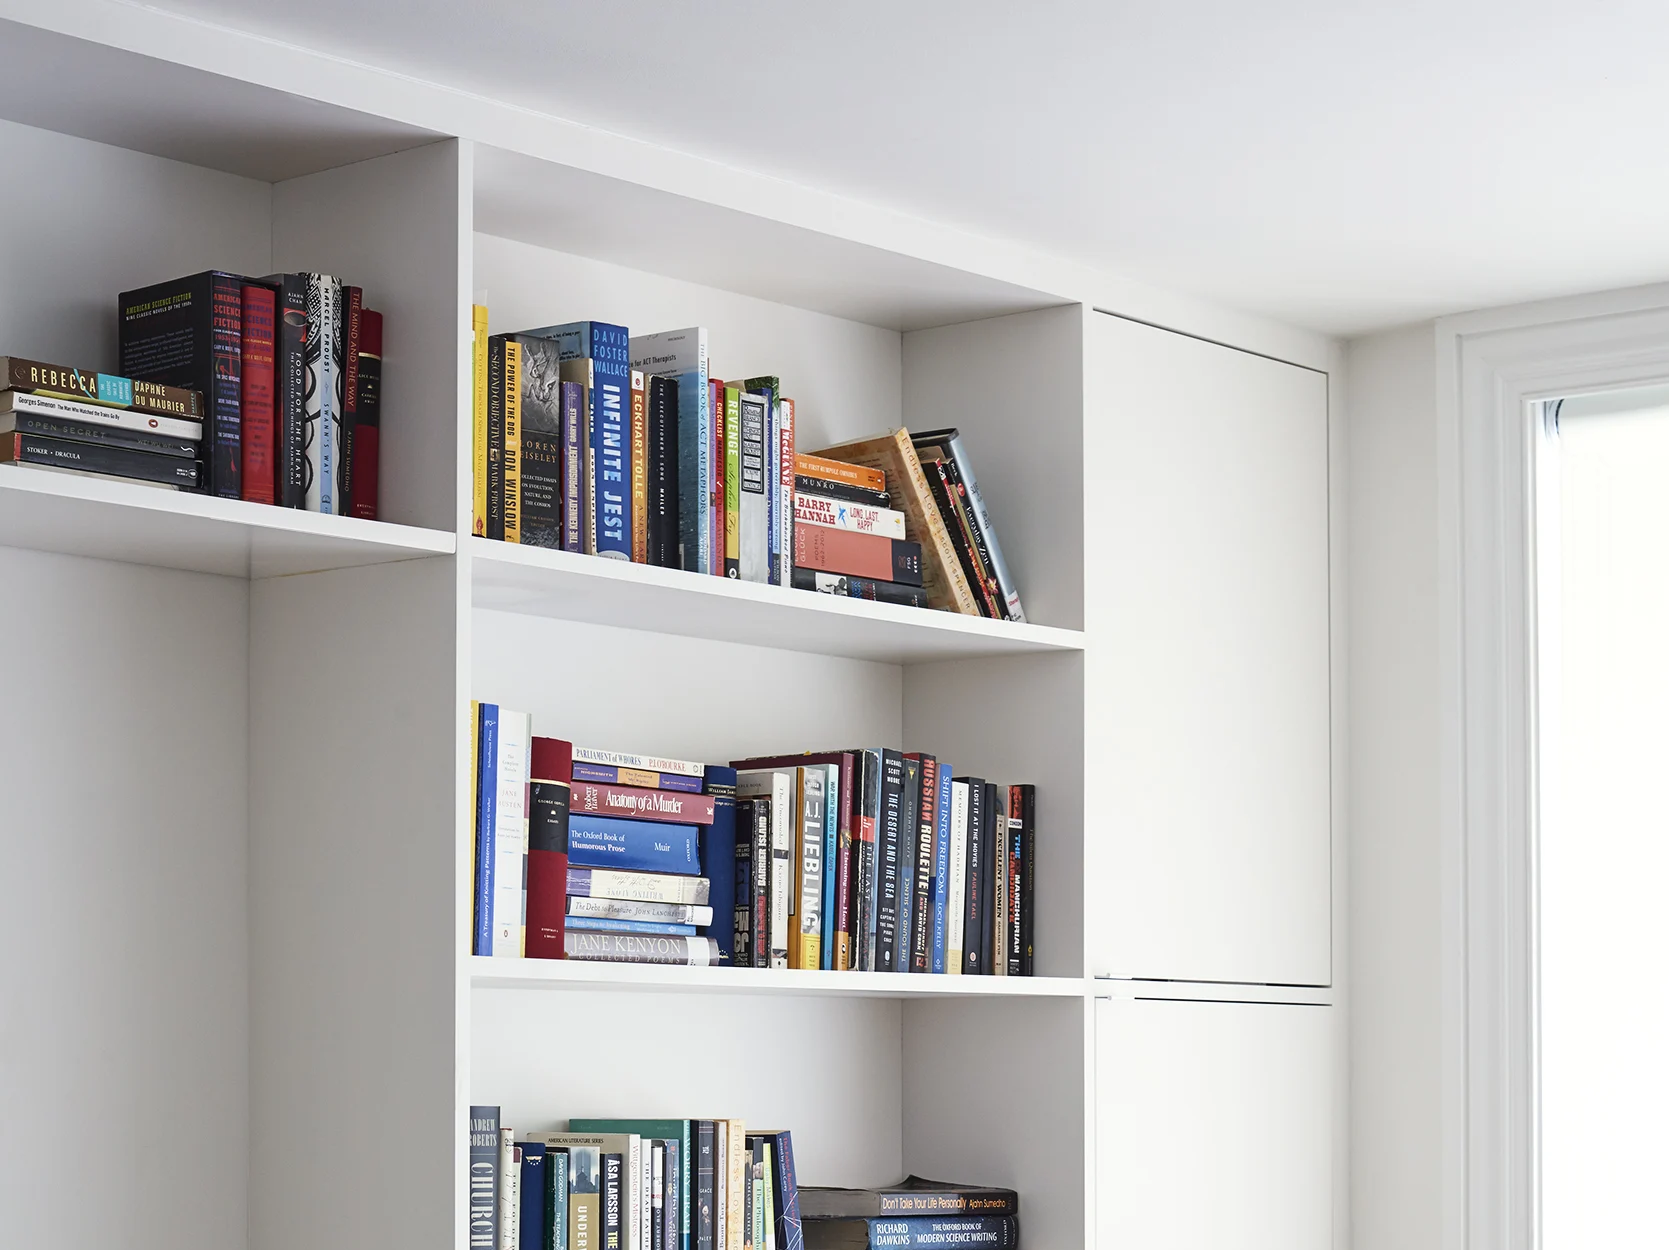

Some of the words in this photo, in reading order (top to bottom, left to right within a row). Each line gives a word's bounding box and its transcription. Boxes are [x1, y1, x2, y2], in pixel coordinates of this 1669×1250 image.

[126, 302, 150, 315] AMERICAN
[152, 297, 171, 310] SCIENCE
[172, 292, 192, 303] FICTION
[352, 293, 360, 309] THE
[350, 313, 359, 339] MIND
[594, 329, 628, 346] DAVID
[349, 340, 358, 362] AND
[507, 348, 515, 361] THE
[594, 345, 628, 362] FOSTER
[642, 357, 651, 365] ACT
[652, 354, 677, 364] Therapists
[348, 366, 357, 388] THE
[507, 364, 515, 392] POWER
[594, 361, 628, 377] WALLACE
[31, 367, 96, 393] REBECCA
[135, 381, 165, 396] DAPHNE
[135, 395, 146, 406] DU
[149, 397, 185, 413] MAURIER
[347, 389, 356, 406] WAY
[507, 394, 515, 404] OF
[507, 406, 515, 420] THE
[27, 420, 57, 431] OPEN
[63, 425, 105, 439] SECRET
[507, 421, 515, 436] DOG
[602, 384, 623, 482] INFINITE
[634, 394, 643, 456] ECKHART
[728, 400, 738, 457] REVENGE
[27, 446, 48, 455] STOKER
[55, 450, 80, 460] DRACULA
[505, 450, 516, 471] DON
[491, 462, 499, 488] MARK
[569, 444, 578, 497] IMPRISONMENT
[635, 458, 643, 499] TOLLE
[808, 463, 820, 471] FIRST
[820, 465, 839, 475] RUMPOLE
[839, 469, 858, 479] OMNIBUS
[901, 437, 923, 489] Endless
[923, 494, 939, 523] Love
[802, 478, 835, 490] MUNRO
[491, 490, 499, 520] FROST
[505, 478, 517, 530] WINSLOW
[798, 497, 832, 513] BARRY
[569, 498, 578, 530] KENNEDY
[603, 491, 623, 541] JEST
[795, 508, 836, 525] HANNAH
[857, 519, 873, 532] HAPPY
[569, 530, 578, 544] THE
[966, 506, 981, 544] Everyday
[979, 547, 989, 565] Zen
[940, 536, 954, 566] SCOTT
[953, 565, 971, 610] SPENCER
[576, 748, 612, 762] PARLIAMENT
[612, 753, 617, 762] of
[618, 754, 642, 766] WHORES
[501, 789, 517, 798] JANE
[584, 786, 592, 810] Robert
[922, 759, 935, 822] RUSSIAN
[941, 776, 950, 807] SHIFT
[498, 800, 522, 809] AUSTEN
[888, 793, 899, 808] THE
[758, 816, 767, 847] ISLAND
[887, 810, 897, 842] DESERT
[940, 809, 949, 838] INTO
[571, 830, 582, 839] The
[582, 831, 603, 841] Oxford
[603, 833, 618, 842] Book
[618, 834, 625, 843] of
[572, 841, 606, 852] Humorous
[607, 843, 626, 853] Prose
[654, 841, 671, 852] Muir
[886, 844, 896, 862] AND
[918, 824, 932, 890] ROULETTE
[758, 848, 767, 886] BARRIER
[802, 820, 821, 927] LIEBLING
[886, 865, 896, 880] THE
[937, 841, 947, 894] FREEDOM
[885, 882, 895, 899] SEA
[903, 907, 908, 918] OF
[1013, 874, 1021, 954] MANCHURIAN
[570, 933, 612, 954] JANE
[613, 935, 681, 955] KENYON
[732, 1124, 742, 1183] Endless
[607, 1159, 621, 1180] ÅSA
[629, 1145, 639, 1203] Wittgenstein's
[607, 1181, 619, 1226] LARSSON
[755, 1186, 763, 1204] The
[882, 1198, 900, 1210] Don't
[899, 1198, 913, 1209] Take
[913, 1198, 928, 1209] Your
[927, 1198, 938, 1209] Life
[938, 1197, 967, 1211] Personally
[969, 1200, 984, 1209] Ajahn
[983, 1199, 1006, 1208] Sumedho
[732, 1190, 742, 1226] Love
[631, 1203, 639, 1238] Mistress
[876, 1223, 909, 1234] RICHARD
[932, 1223, 942, 1231] THE
[942, 1223, 961, 1231] OXFORD
[961, 1223, 974, 1231] BOOK
[974, 1222, 982, 1230] OF
[607, 1231, 619, 1249] THE
[876, 1234, 910, 1246] DAWKINS
[917, 1233, 945, 1244] MODERN
[945, 1232, 971, 1243] SCIENCE
[970, 1231, 998, 1241] WRITING
